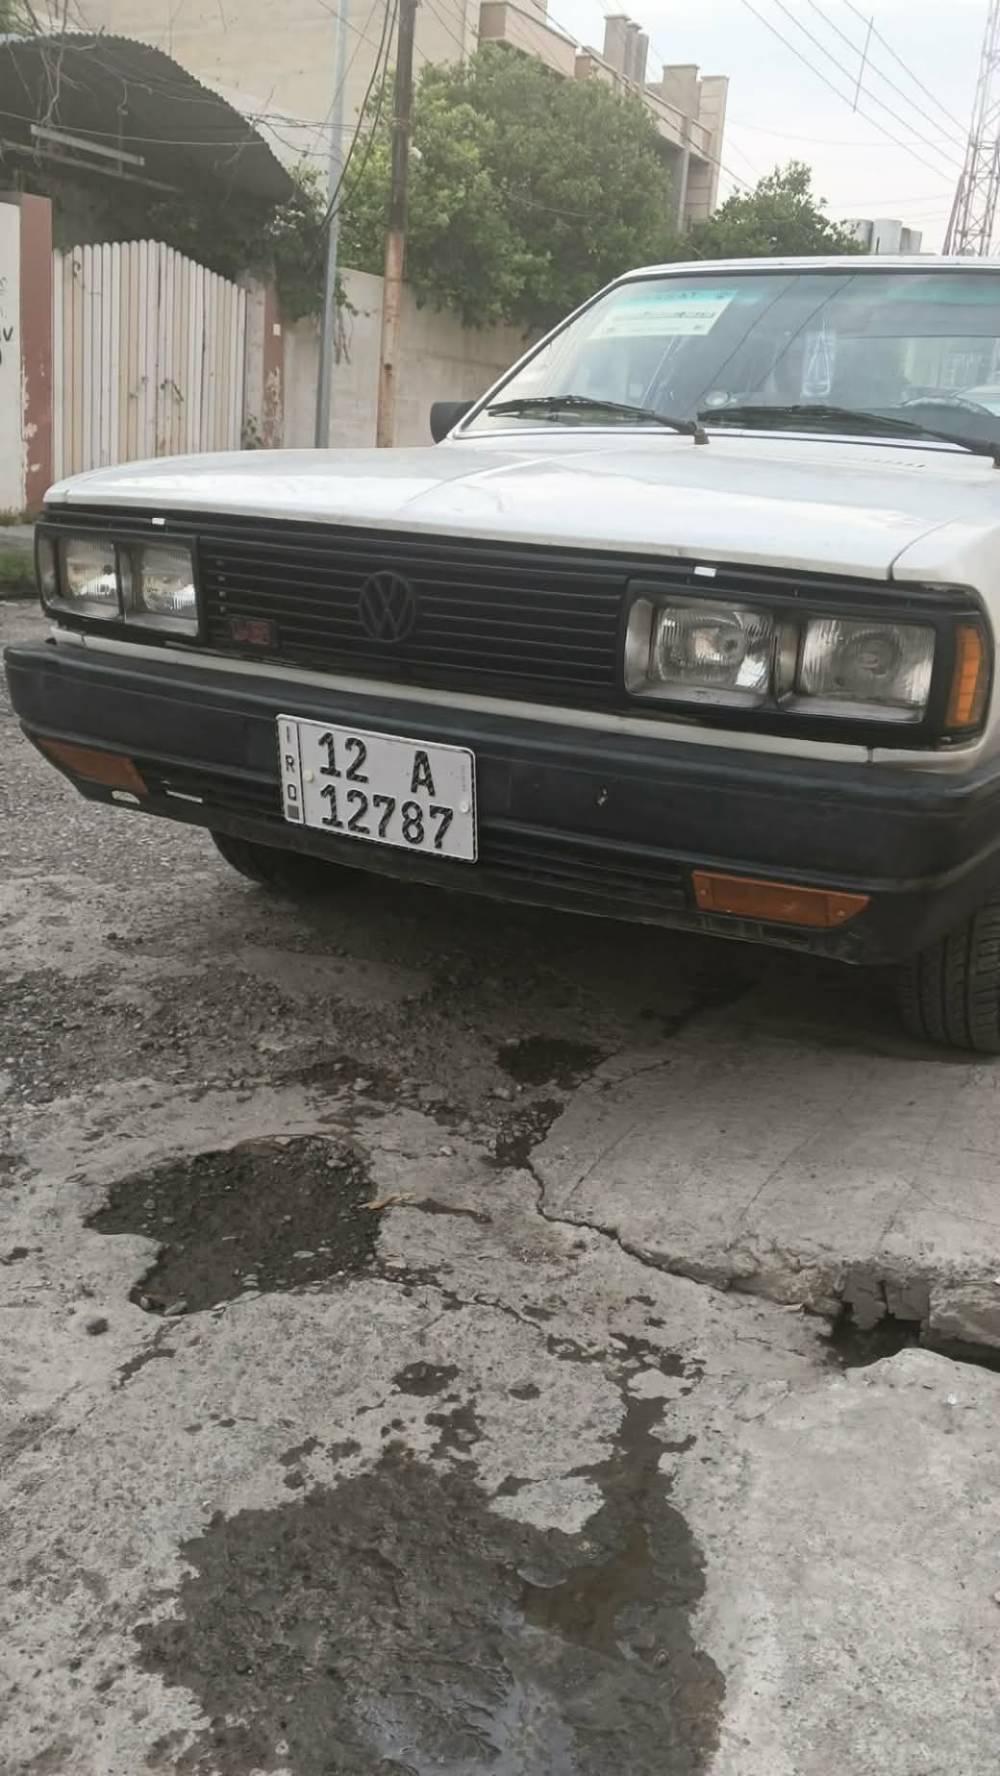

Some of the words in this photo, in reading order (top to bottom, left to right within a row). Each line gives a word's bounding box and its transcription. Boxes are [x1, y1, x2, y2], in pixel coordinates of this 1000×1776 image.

[318, 732, 369, 783] 12
[410, 750, 435, 797] A
[320, 784, 453, 849] 12787
